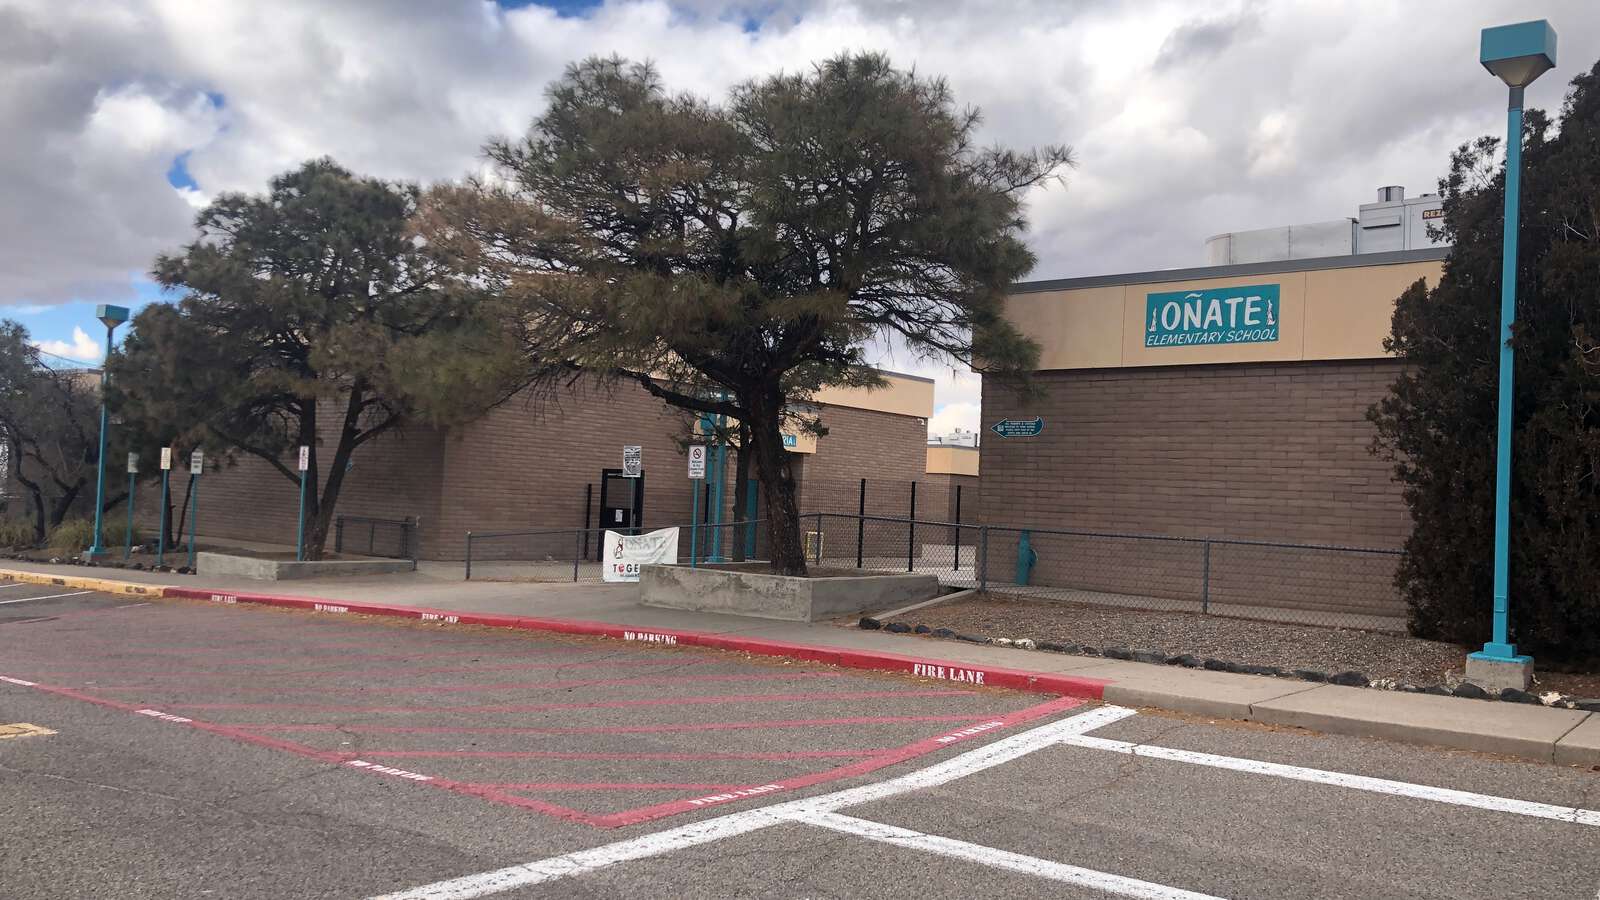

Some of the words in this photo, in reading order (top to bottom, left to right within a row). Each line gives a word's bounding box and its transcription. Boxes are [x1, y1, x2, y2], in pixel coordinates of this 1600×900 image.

[1161, 292, 1262, 331] OÑATE
[1147, 330, 1225, 346] ELEMENTARY
[1226, 328, 1277, 342] SCHOOL
[624, 631, 635, 640] NO
[637, 632, 677, 645] PARKING
[913, 663, 945, 679] FIRE
[949, 667, 984, 685] LANE
